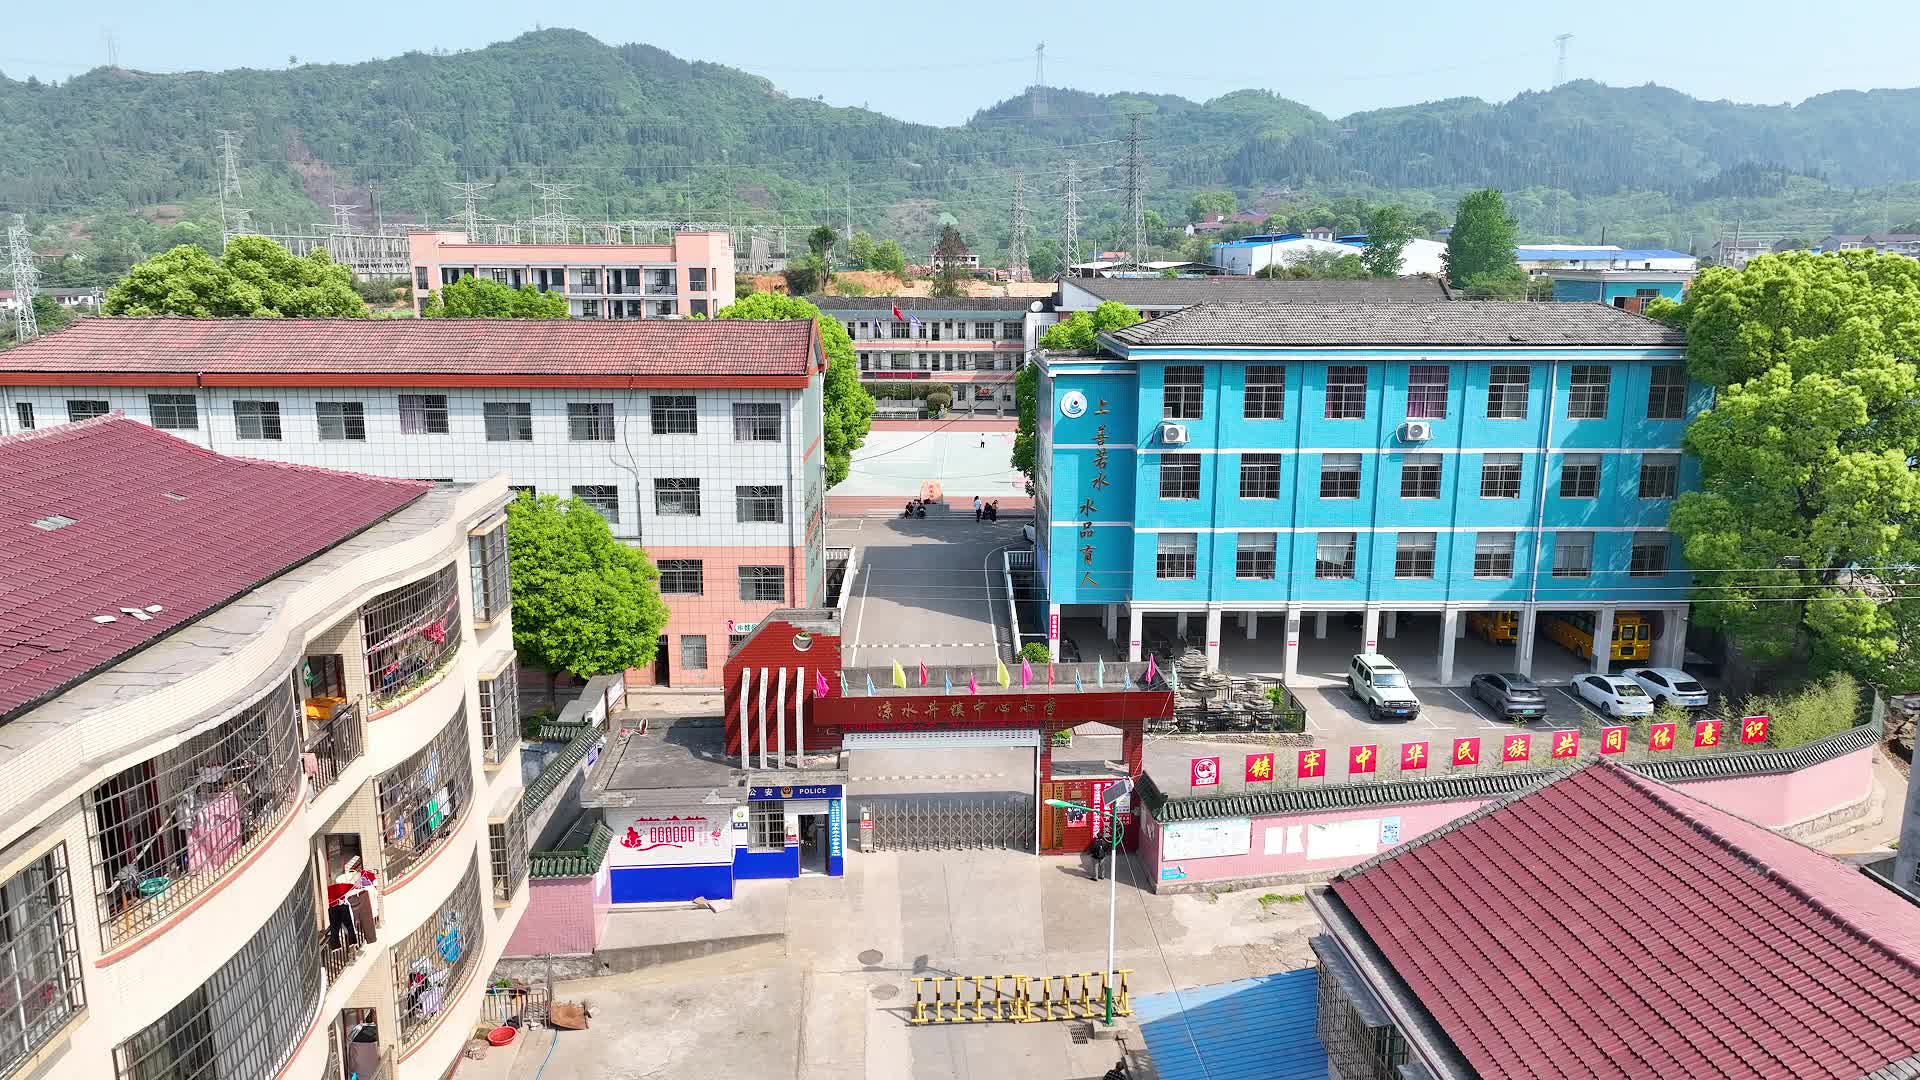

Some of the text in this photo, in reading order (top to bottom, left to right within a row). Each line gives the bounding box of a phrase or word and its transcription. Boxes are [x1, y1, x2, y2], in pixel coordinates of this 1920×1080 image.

[1092, 400, 1110, 491] 上善若水
[1080, 498, 1098, 587] 水品育人
[1248, 719, 1766, 779] 铸牢中华民族共同体意识
[749, 788, 773, 796] 公安
